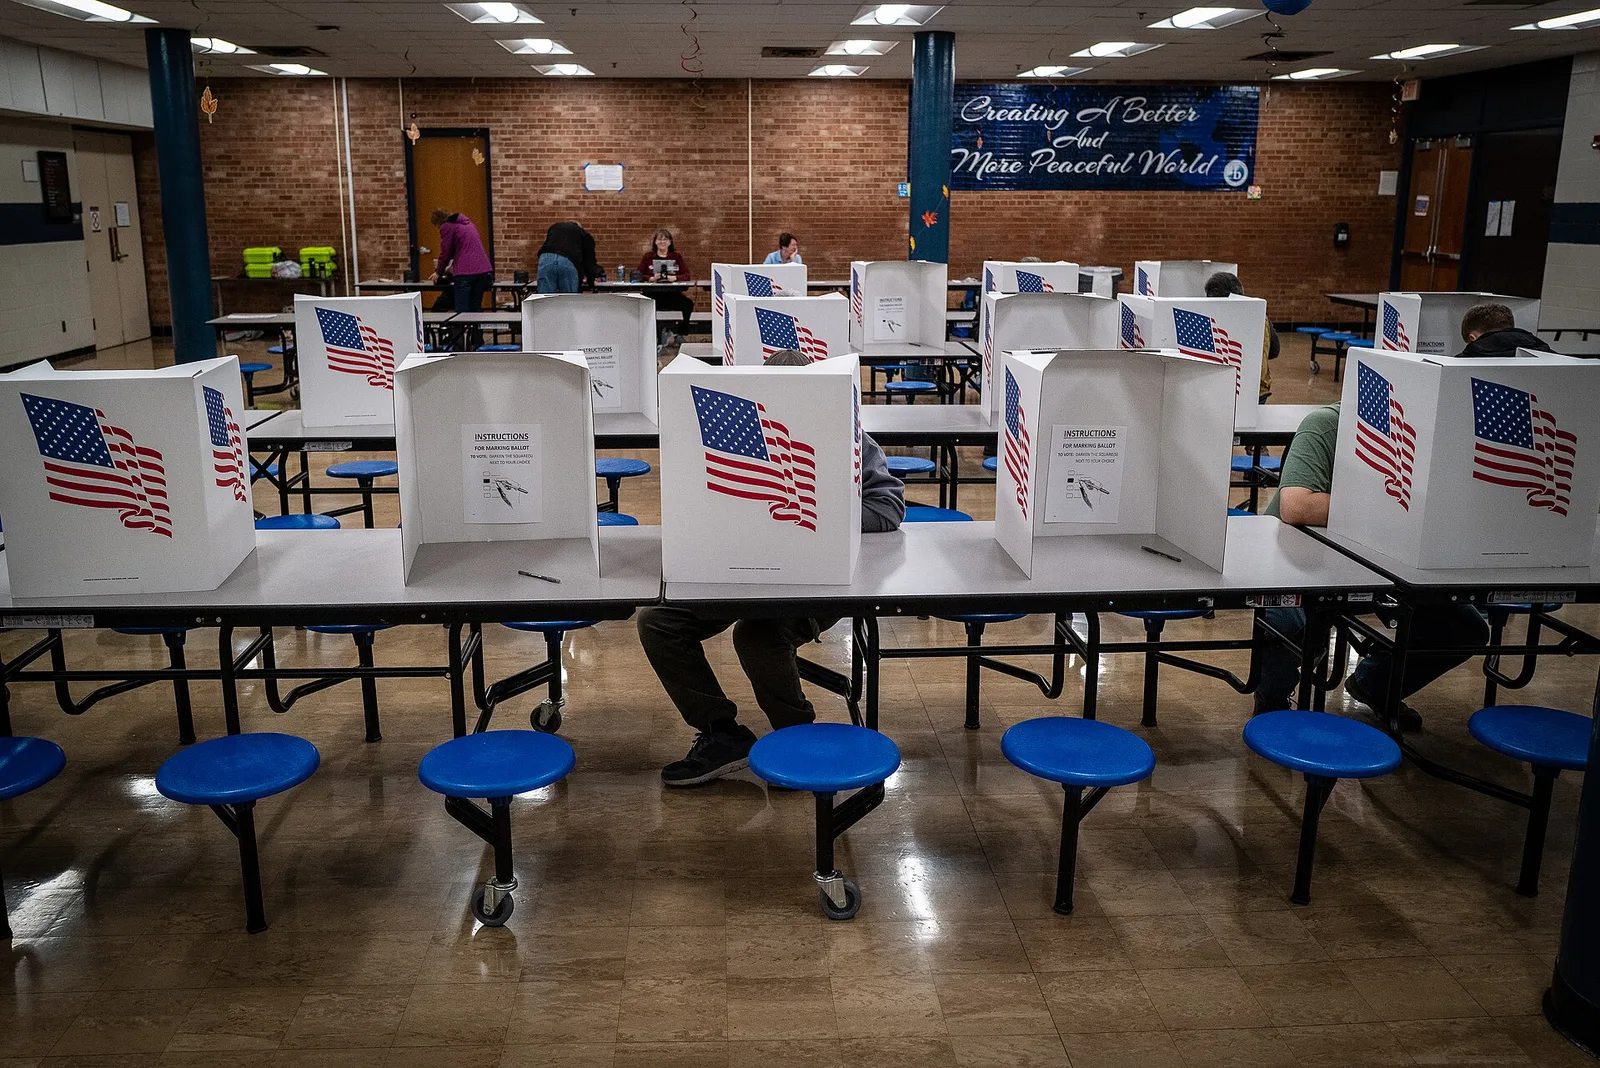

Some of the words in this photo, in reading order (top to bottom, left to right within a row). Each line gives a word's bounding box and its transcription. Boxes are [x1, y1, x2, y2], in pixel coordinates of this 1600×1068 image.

[961, 95, 1070, 131] Creating
[1075, 95, 1124, 125] A
[1122, 96, 1200, 123] Better
[1052, 125, 1110, 150] And
[951, 148, 1024, 181] More
[1028, 148, 1135, 176] Peaceful
[1138, 149, 1219, 177] World
[474, 433, 529, 441] INSTRUCTIONS
[1063, 429, 1117, 438] INSTRUCTIONS
